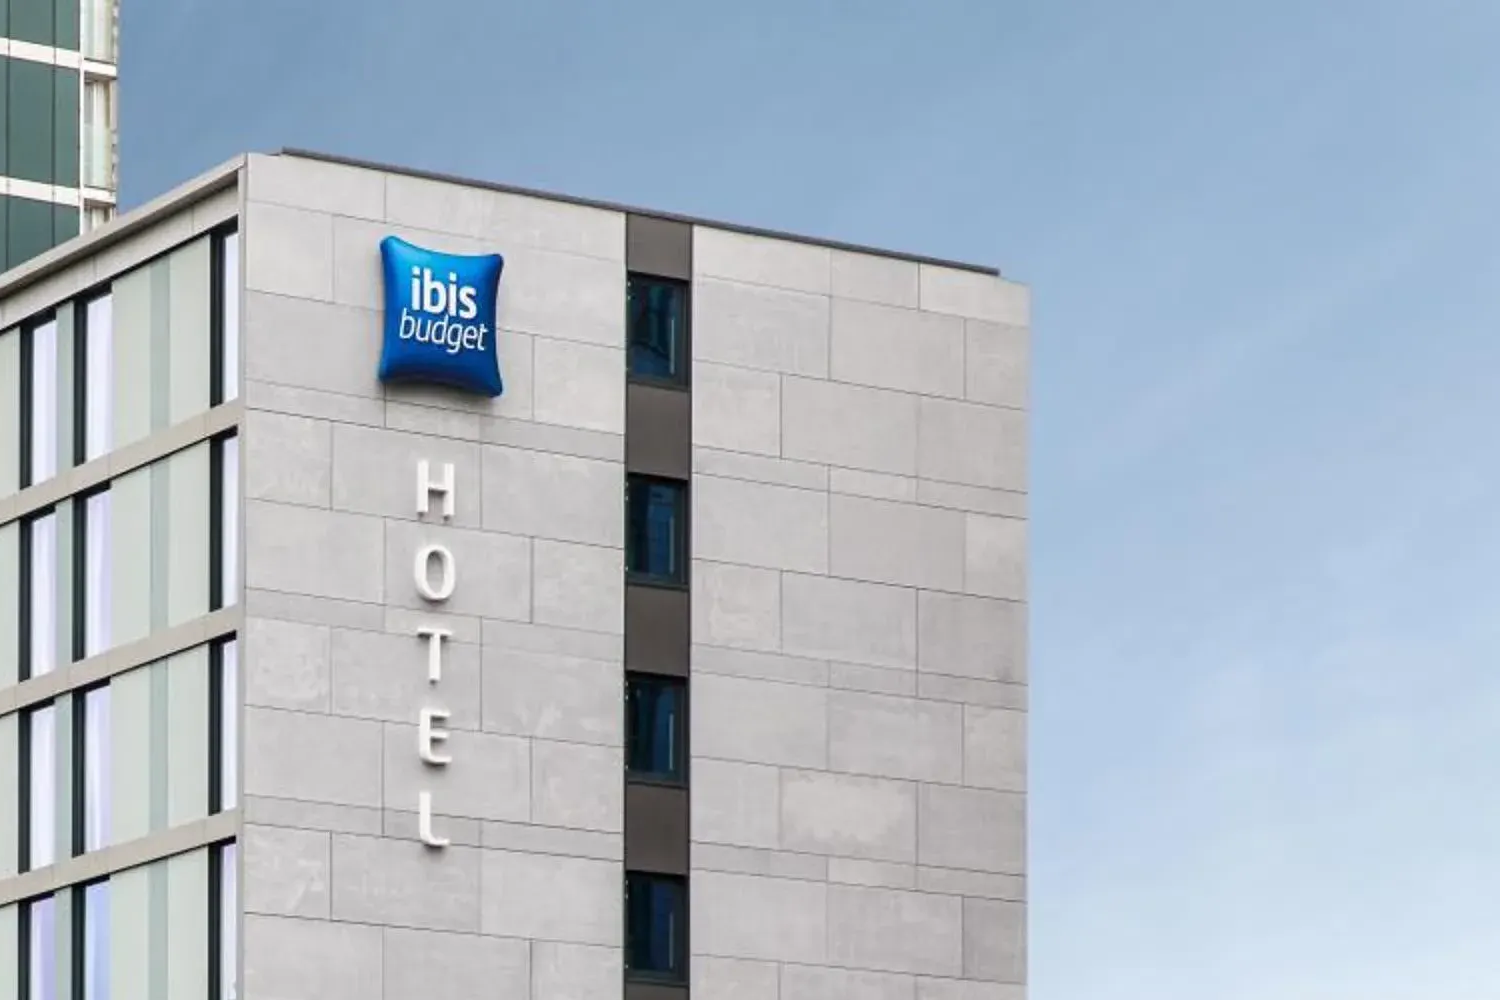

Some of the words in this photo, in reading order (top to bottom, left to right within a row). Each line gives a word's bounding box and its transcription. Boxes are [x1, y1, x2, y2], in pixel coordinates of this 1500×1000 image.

[411, 265, 478, 319] ibis
[399, 307, 489, 355] budget
[414, 459, 455, 846] HOTEL
